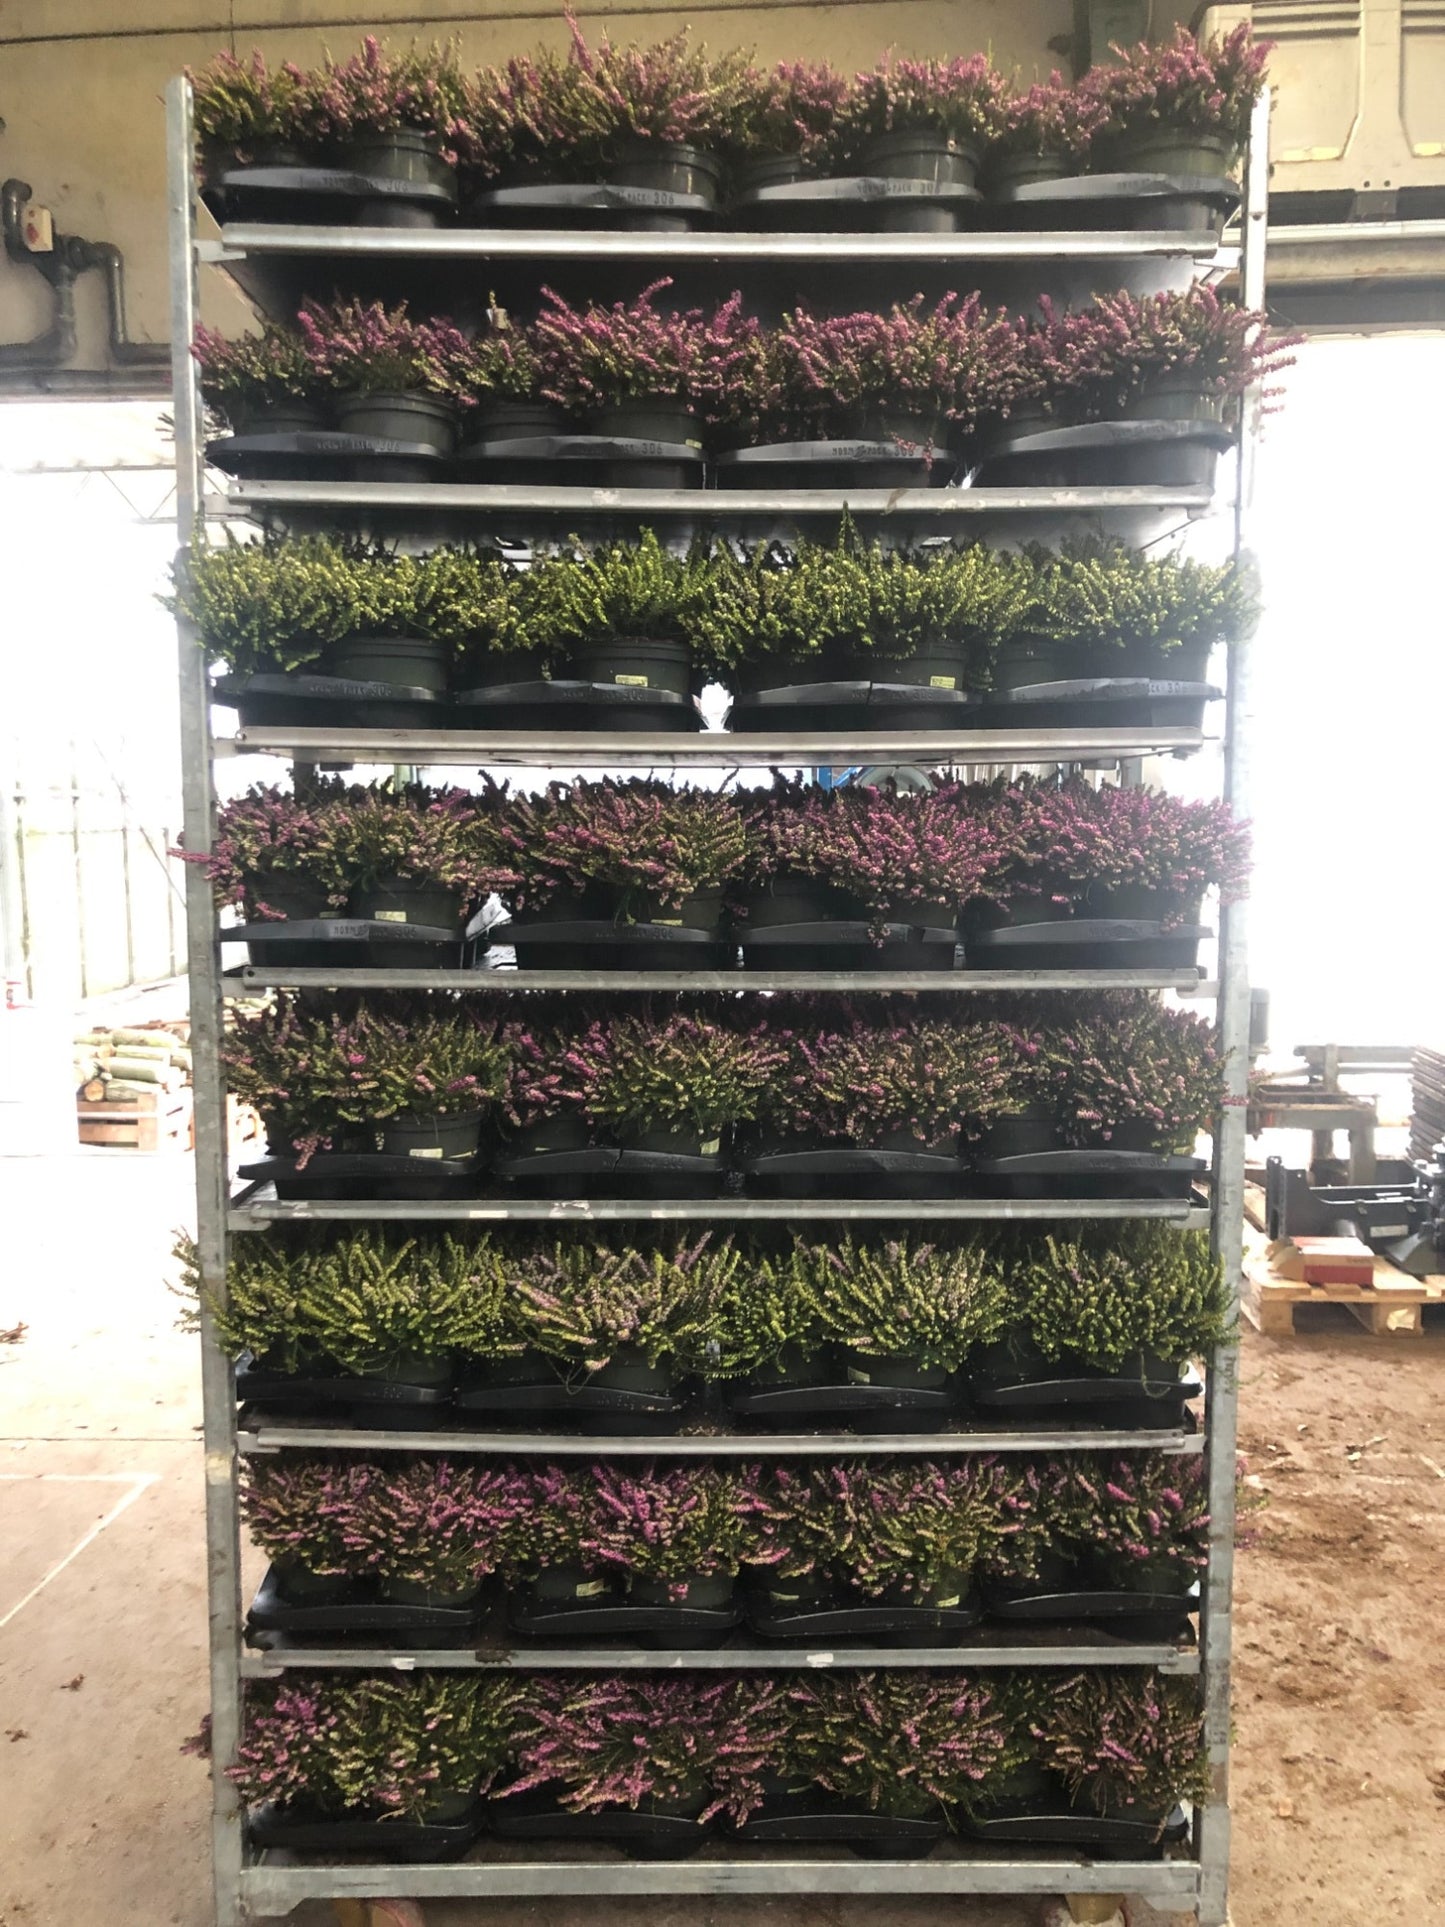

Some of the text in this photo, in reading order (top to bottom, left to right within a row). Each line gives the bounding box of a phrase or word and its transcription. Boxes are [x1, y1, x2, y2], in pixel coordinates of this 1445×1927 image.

[653, 191, 674, 204] 306
[641, 442, 662, 454] 306
[395, 925, 417, 939] 306
[652, 927, 673, 940] 306
